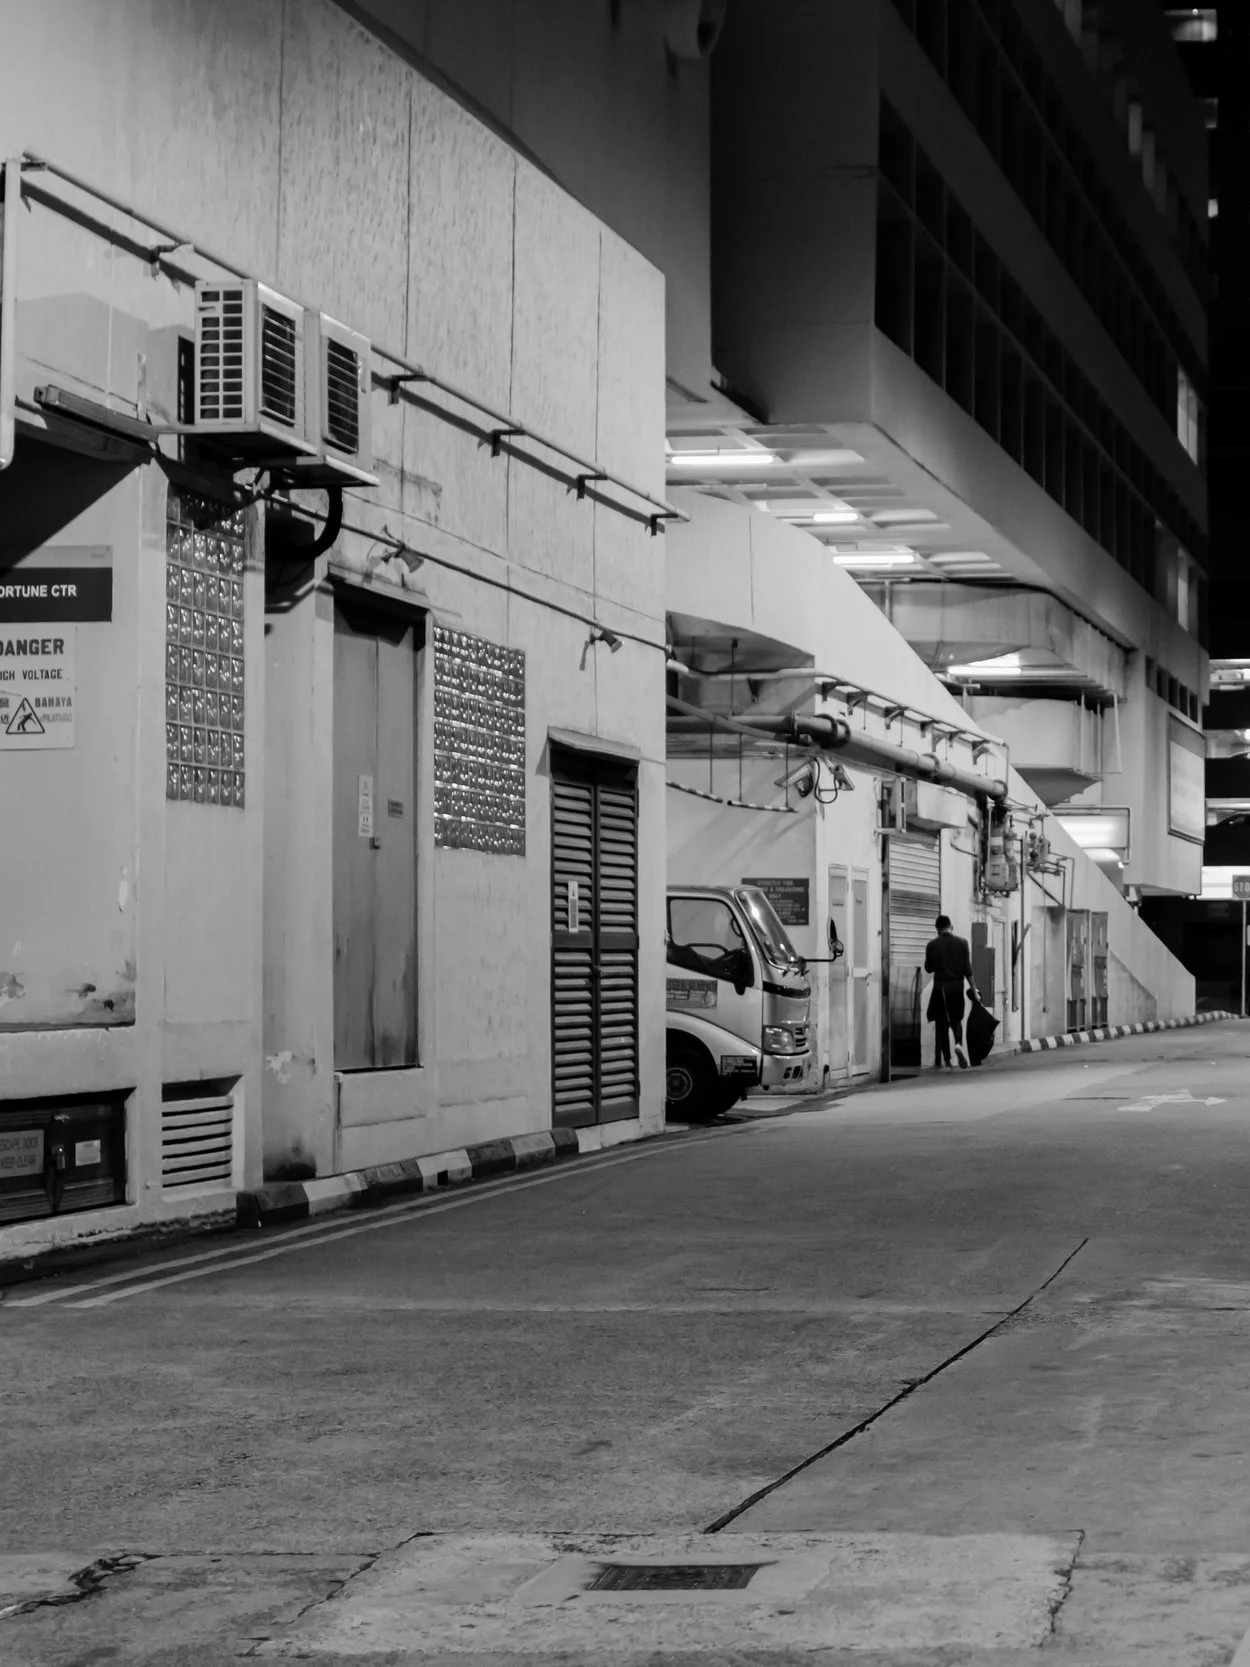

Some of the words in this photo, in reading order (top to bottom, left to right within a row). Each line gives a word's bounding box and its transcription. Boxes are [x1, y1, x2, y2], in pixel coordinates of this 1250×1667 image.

[51, 584, 77, 597] CTR
[22, 668, 63, 680] VOLTAGE
[35, 696, 72, 708] BAHAYA
